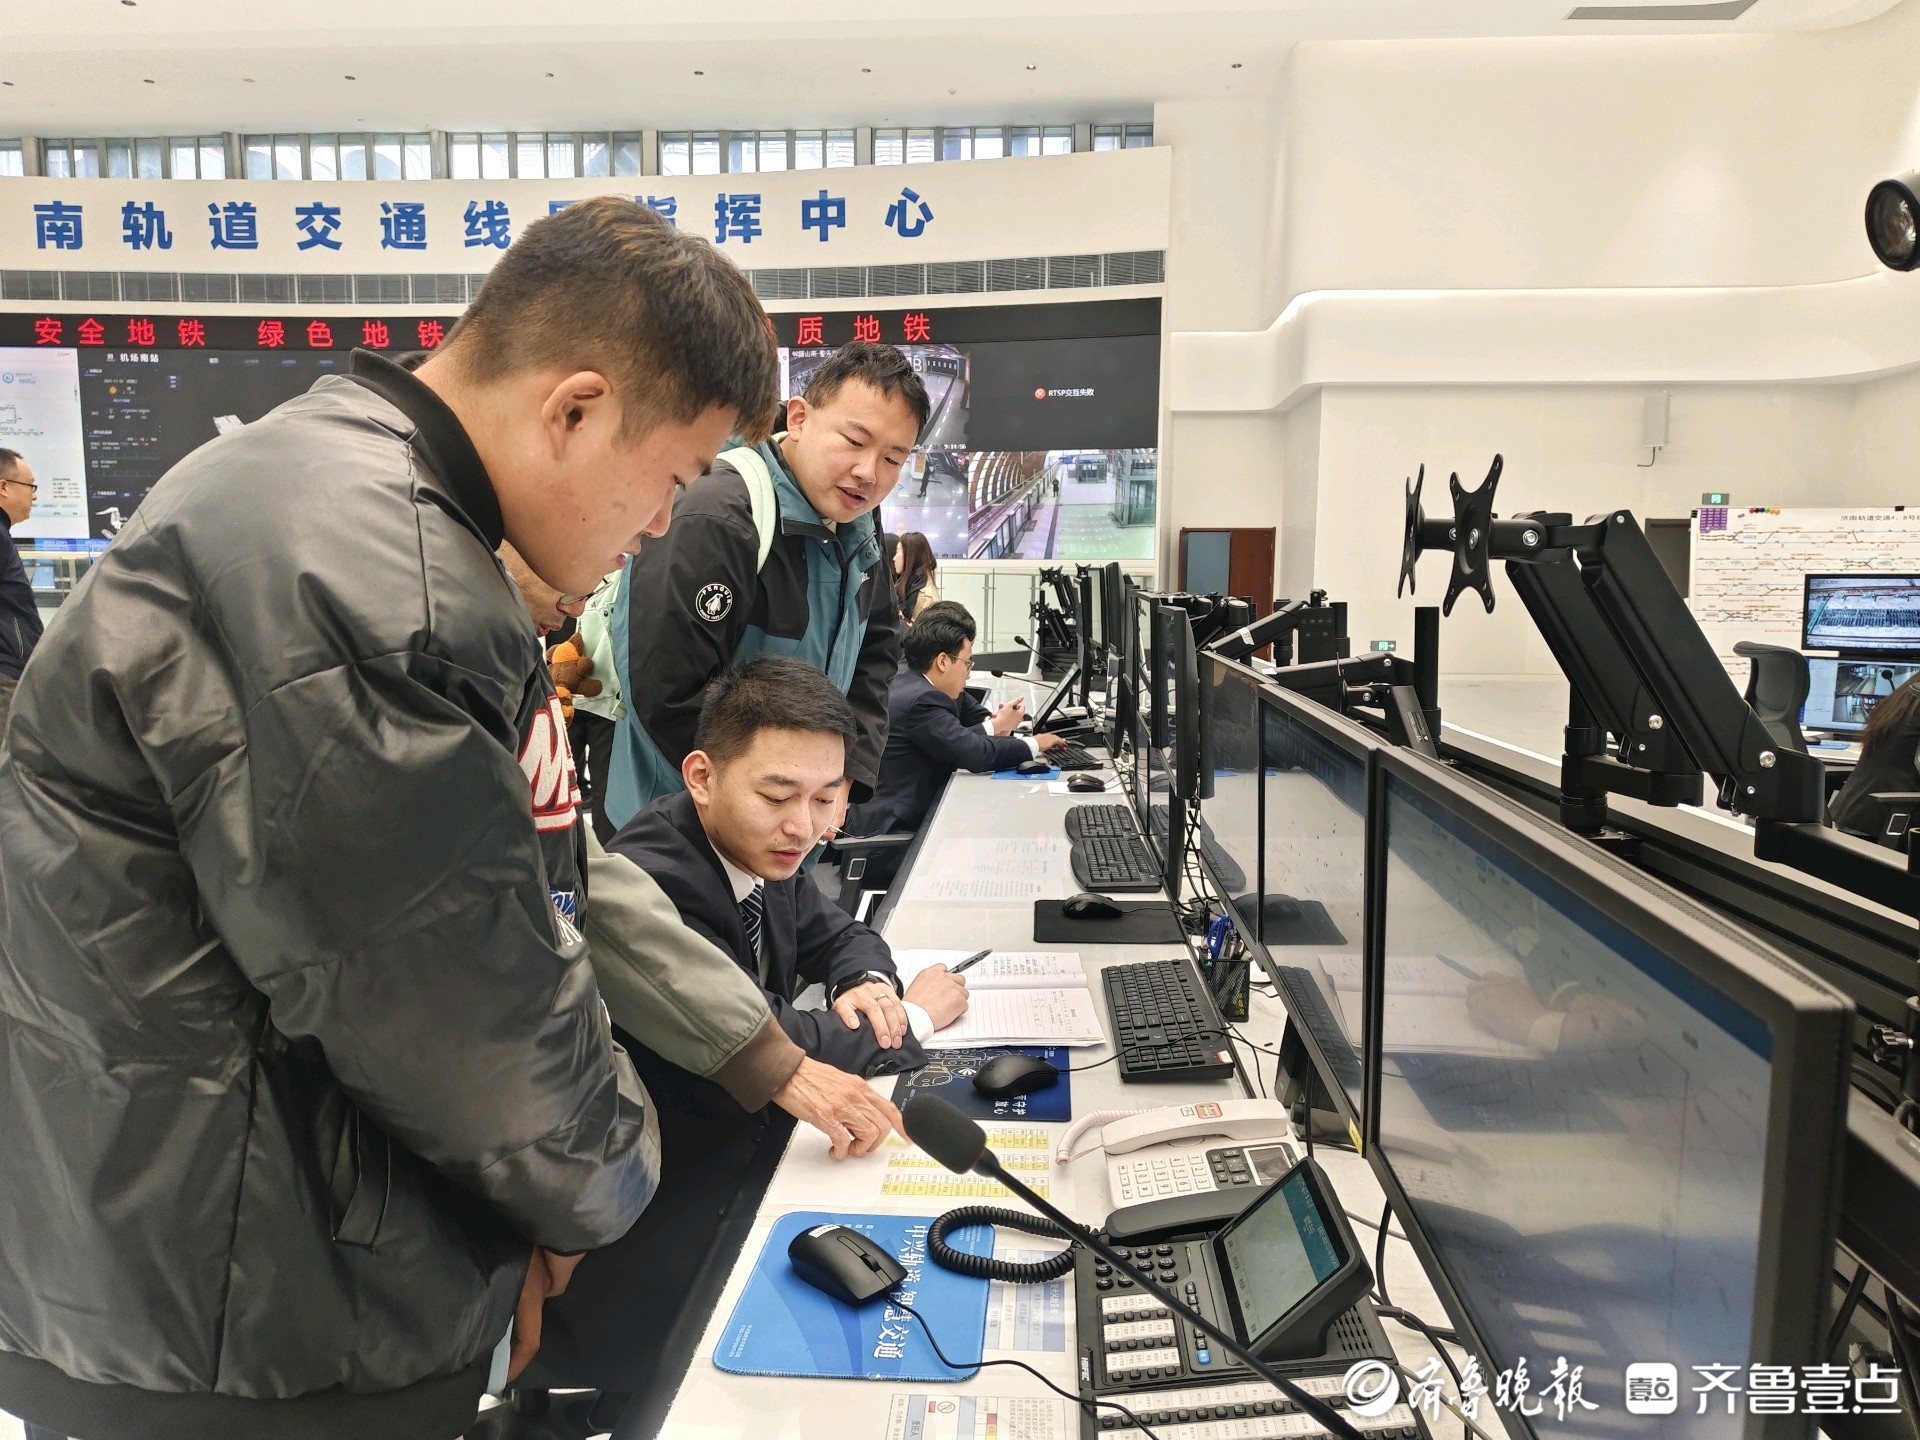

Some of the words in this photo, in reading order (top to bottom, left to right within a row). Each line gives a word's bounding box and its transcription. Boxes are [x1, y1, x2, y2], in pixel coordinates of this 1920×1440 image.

[34, 318, 206, 347] 安全地铁
[257, 319, 445, 349] 绿色地铁
[767, 313, 931, 345] 质地铁
[120, 353, 160, 364] 机场南站
[1048, 388, 1095, 398] RTSP交互失败
[701, 585, 732, 604] PENGUIN
